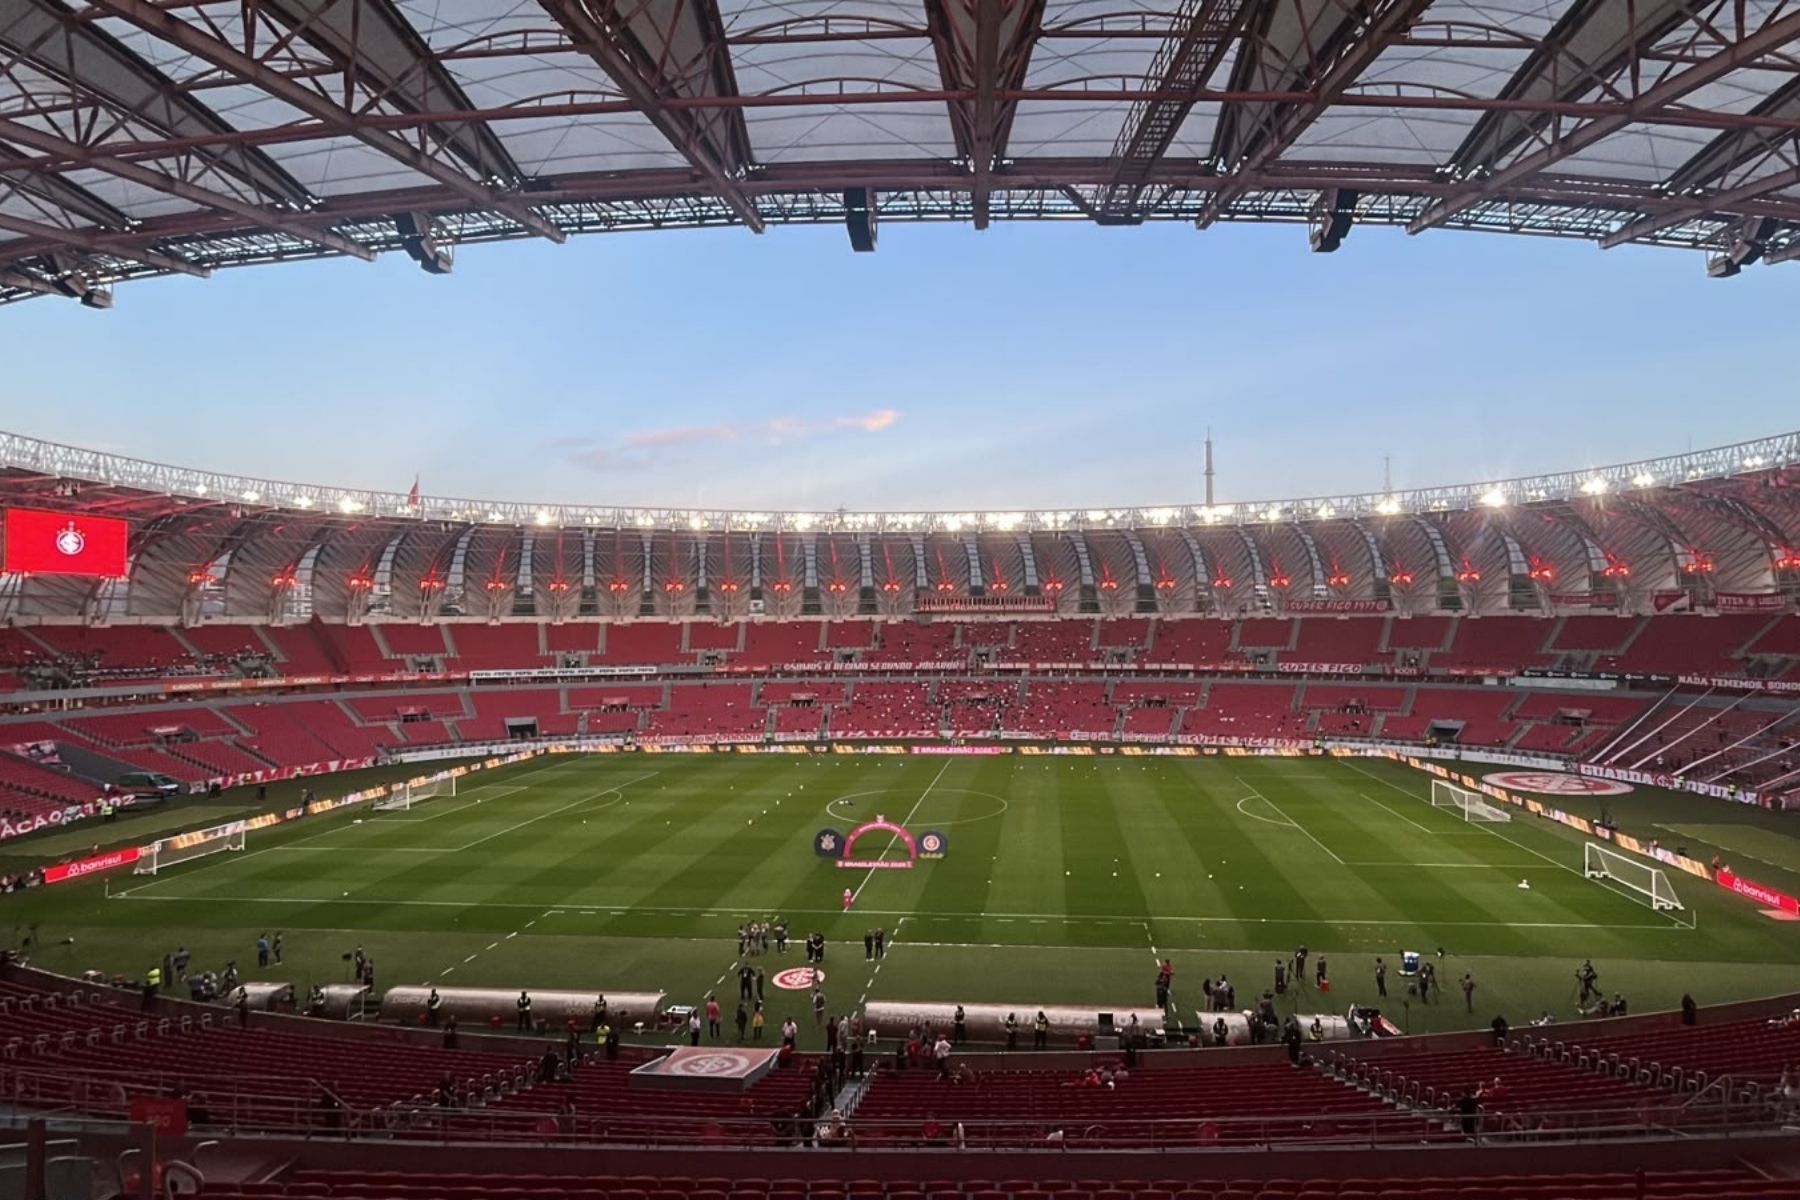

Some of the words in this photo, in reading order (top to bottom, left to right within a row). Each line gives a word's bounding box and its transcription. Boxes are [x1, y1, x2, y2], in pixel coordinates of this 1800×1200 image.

[1290, 600, 1324, 610] SUPER
[1280, 663, 1324, 673] SUPER
[1678, 675, 1708, 686] NADA
[1580, 764, 1654, 784] GUARDA
[81, 853, 121, 872] banrisul
[1742, 882, 1780, 905] banrisul
